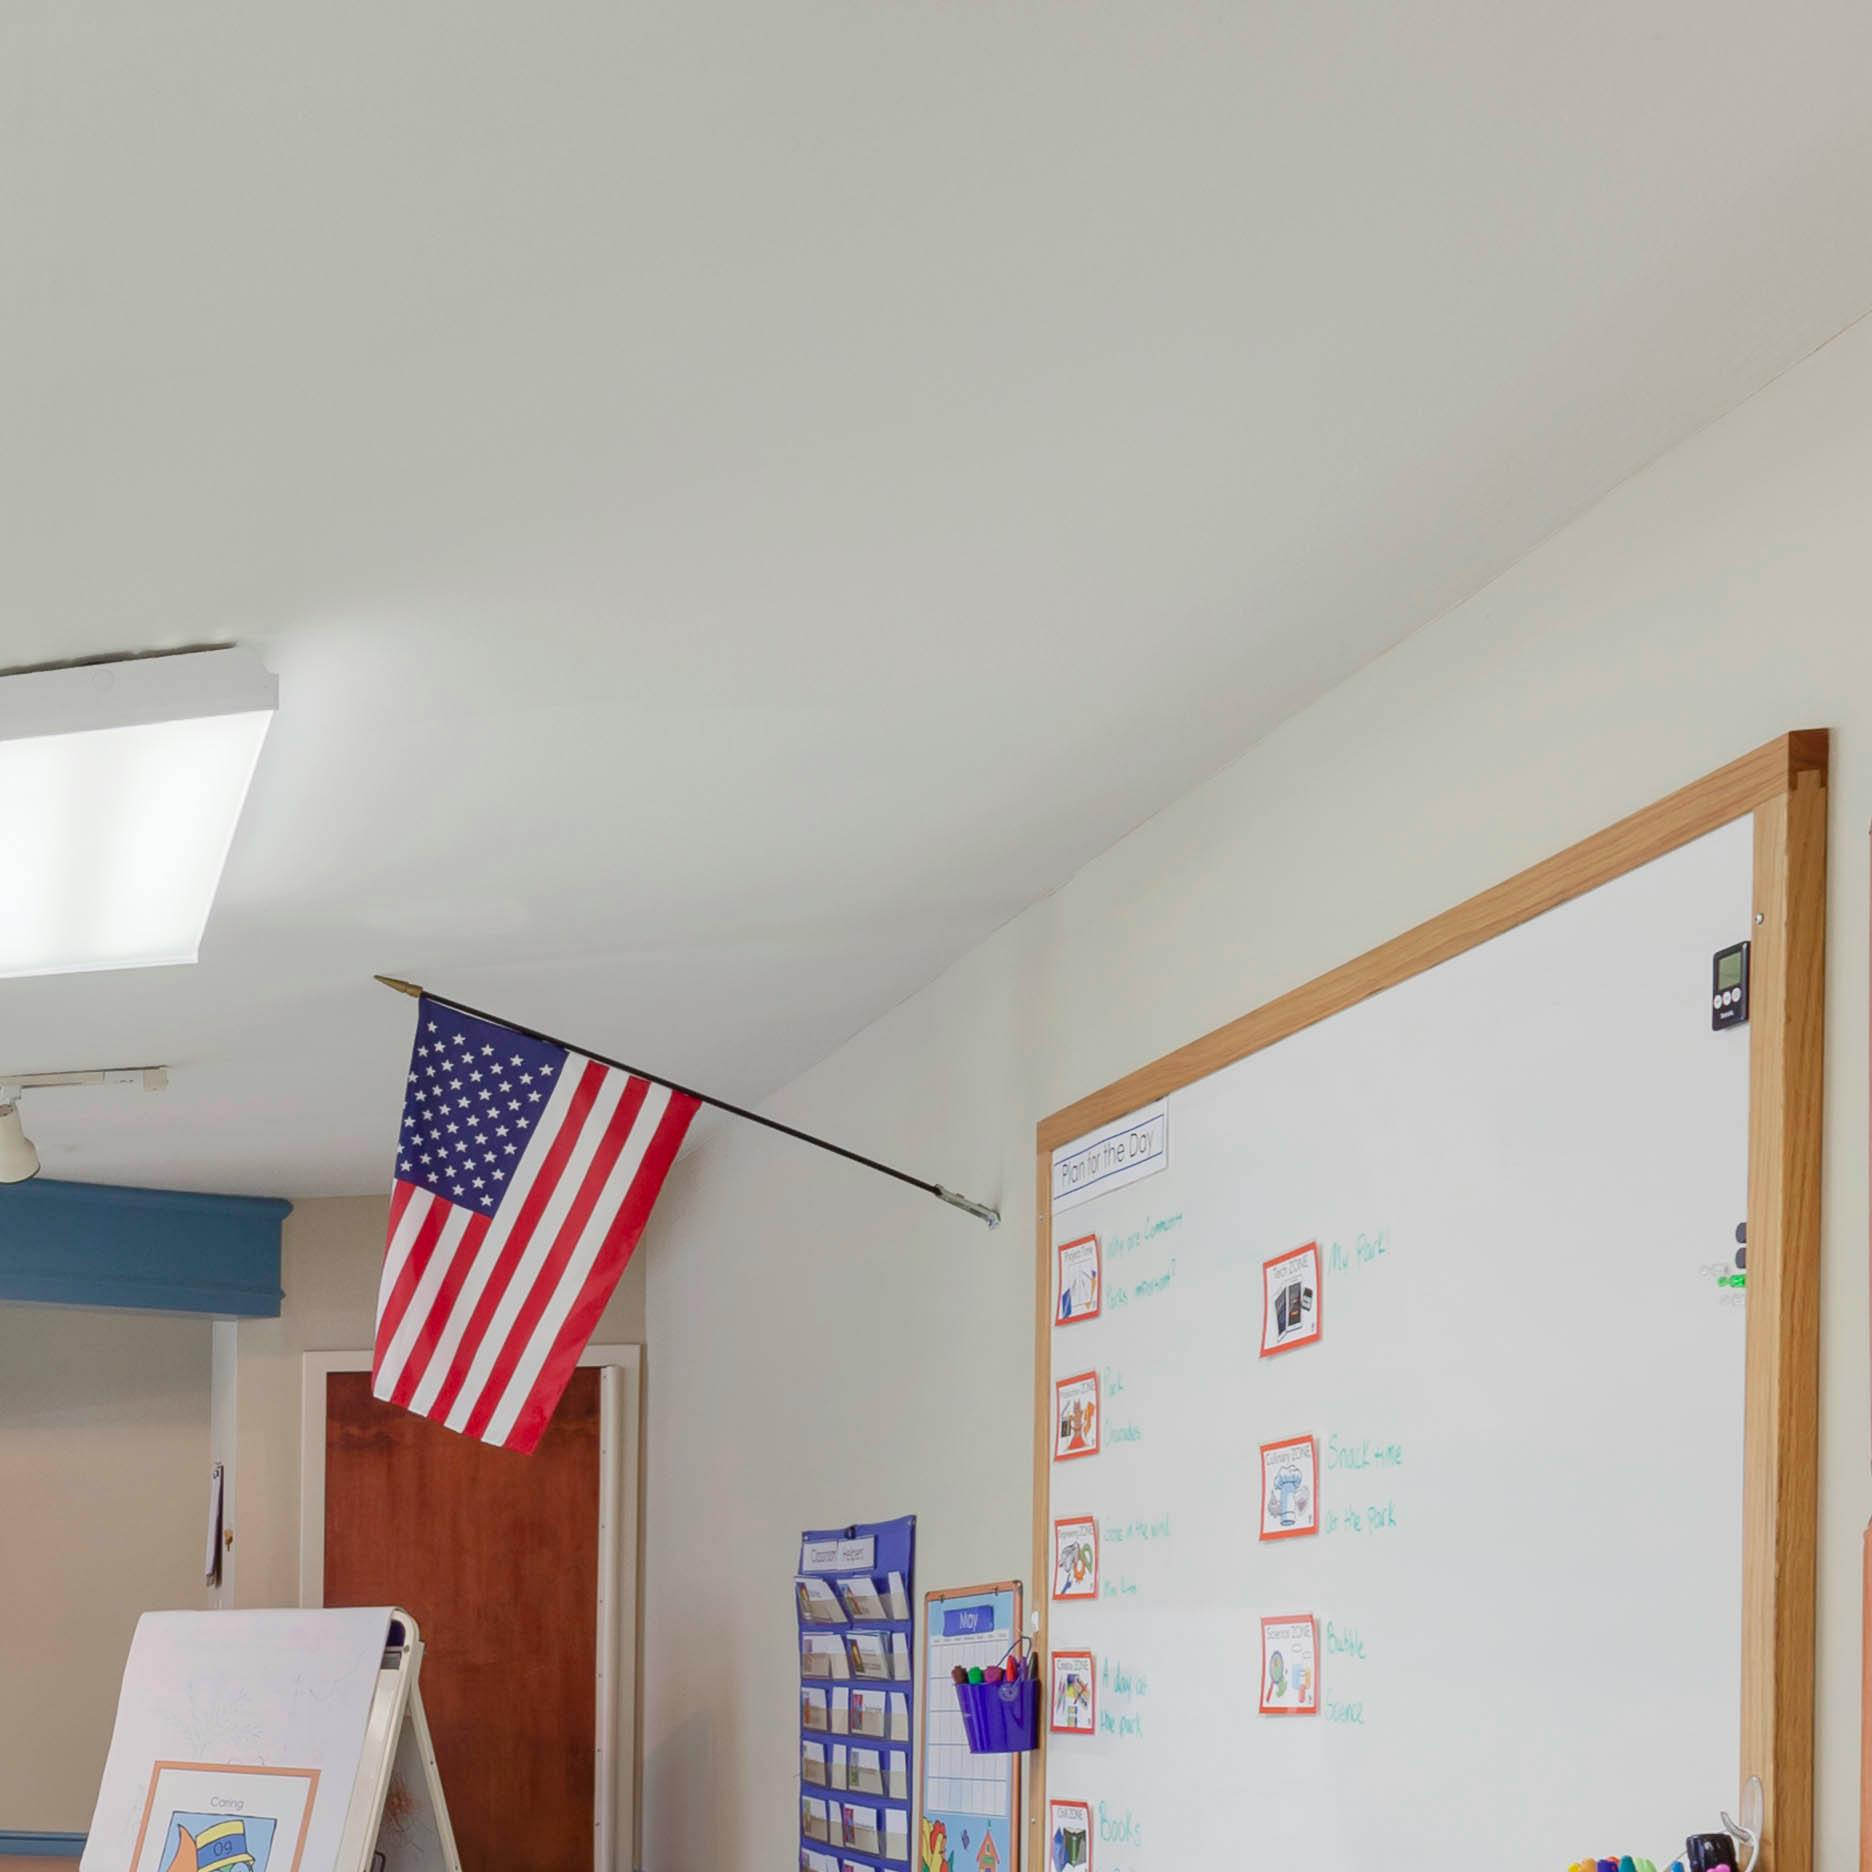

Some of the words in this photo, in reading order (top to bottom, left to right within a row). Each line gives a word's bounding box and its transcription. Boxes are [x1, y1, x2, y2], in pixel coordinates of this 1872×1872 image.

[1060, 1161, 1086, 1187] Plan
[1087, 1152, 1102, 1176] for
[1103, 1143, 1126, 1169] the
[1128, 1129, 1155, 1158] Day
[1288, 1256, 1309, 1275] ZONE
[1292, 1444, 1312, 1462] ZONE
[959, 1611, 979, 1633] May
[1290, 1624, 1312, 1640] ZONE
[209, 1796, 245, 1811] Caring
[213, 1840, 233, 1857] Og
